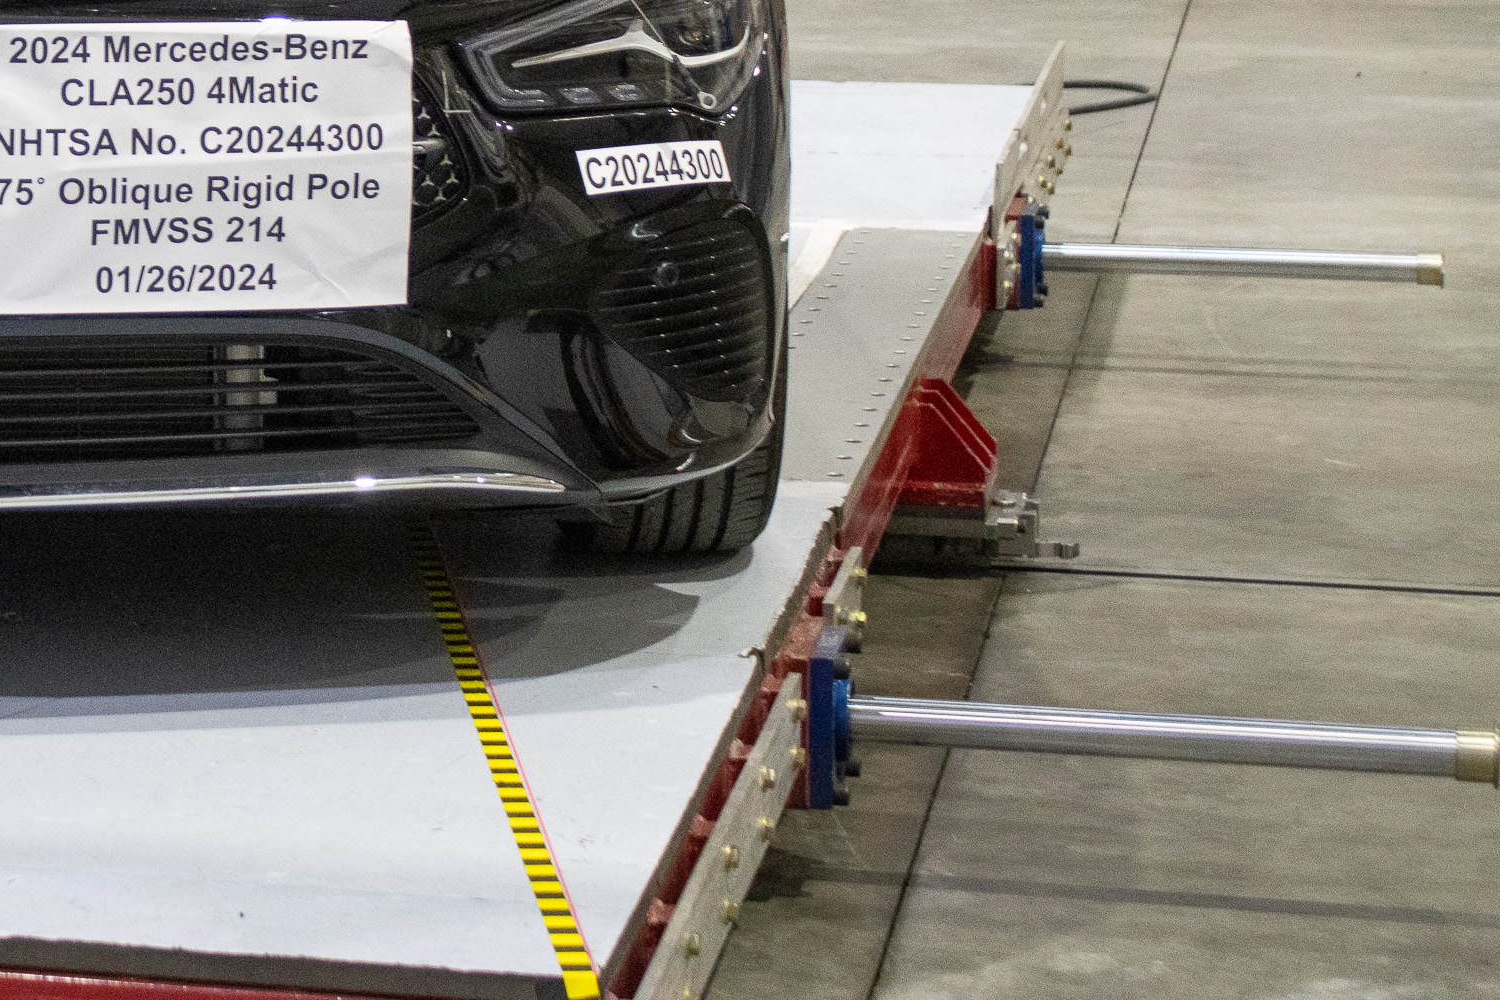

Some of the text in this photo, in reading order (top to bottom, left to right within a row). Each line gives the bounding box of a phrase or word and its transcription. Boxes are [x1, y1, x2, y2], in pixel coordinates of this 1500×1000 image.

[10, 34, 368, 64] 2024 Mercedes-Benz
[61, 76, 318, 106] CLA250 4Matic
[132, 128, 185, 155] No.
[201, 123, 383, 154] C20244300
[586, 148, 724, 189] C20244300
[59, 178, 193, 210] Oblique
[207, 175, 293, 209] Rigid
[308, 173, 379, 199] Pole
[92, 217, 285, 245] FMVSS 214
[97, 263, 276, 293] 01/26/2024
